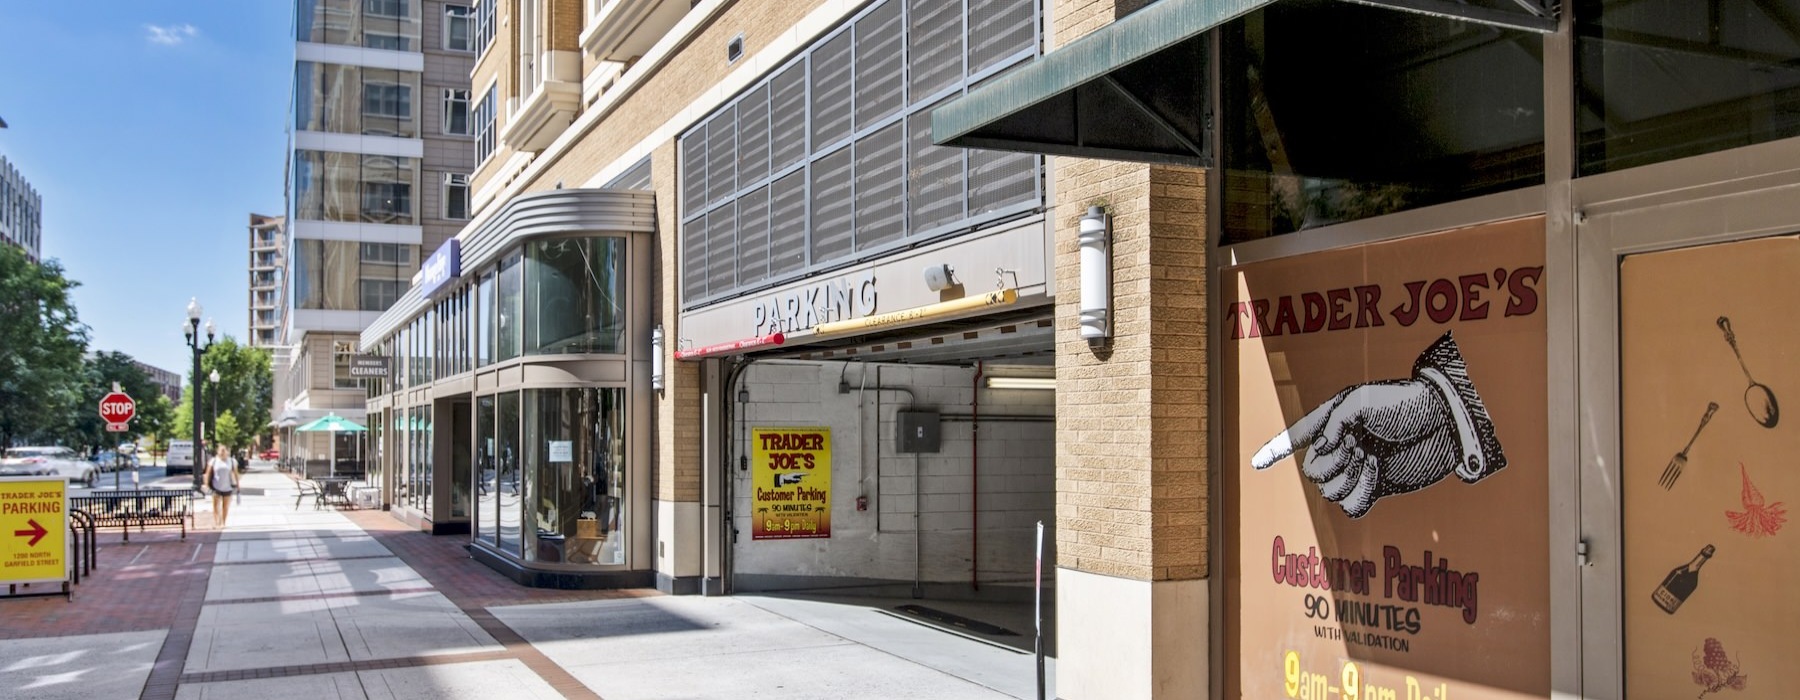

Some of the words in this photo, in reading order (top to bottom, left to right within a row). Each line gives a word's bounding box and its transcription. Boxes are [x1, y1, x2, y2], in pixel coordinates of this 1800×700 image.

[754, 273, 878, 337] PARKING
[1226, 284, 1385, 340] TRADER
[1390, 265, 1544, 327] JOE'S
[865, 312, 906, 327] CLEARANCE
[351, 367, 388, 375] CLEANERS
[103, 402, 133, 415] STOP
[759, 433, 824, 450] TRADER
[768, 453, 815, 470] JOE'S
[1, 492, 35, 500] TRADER
[757, 487, 795, 501] Customer
[797, 486, 827, 504] Parking
[3, 501, 60, 514] PARKING
[771, 504, 782, 512] 90
[783, 504, 812, 512] MINUTES
[1272, 535, 1376, 596] Customer
[1383, 545, 1479, 624] Parking
[1304, 594, 1330, 619] 90
[1335, 600, 1421, 634] MINUTES
[1314, 625, 1341, 641] WITH
[1344, 633, 1410, 652] VALIDATION
